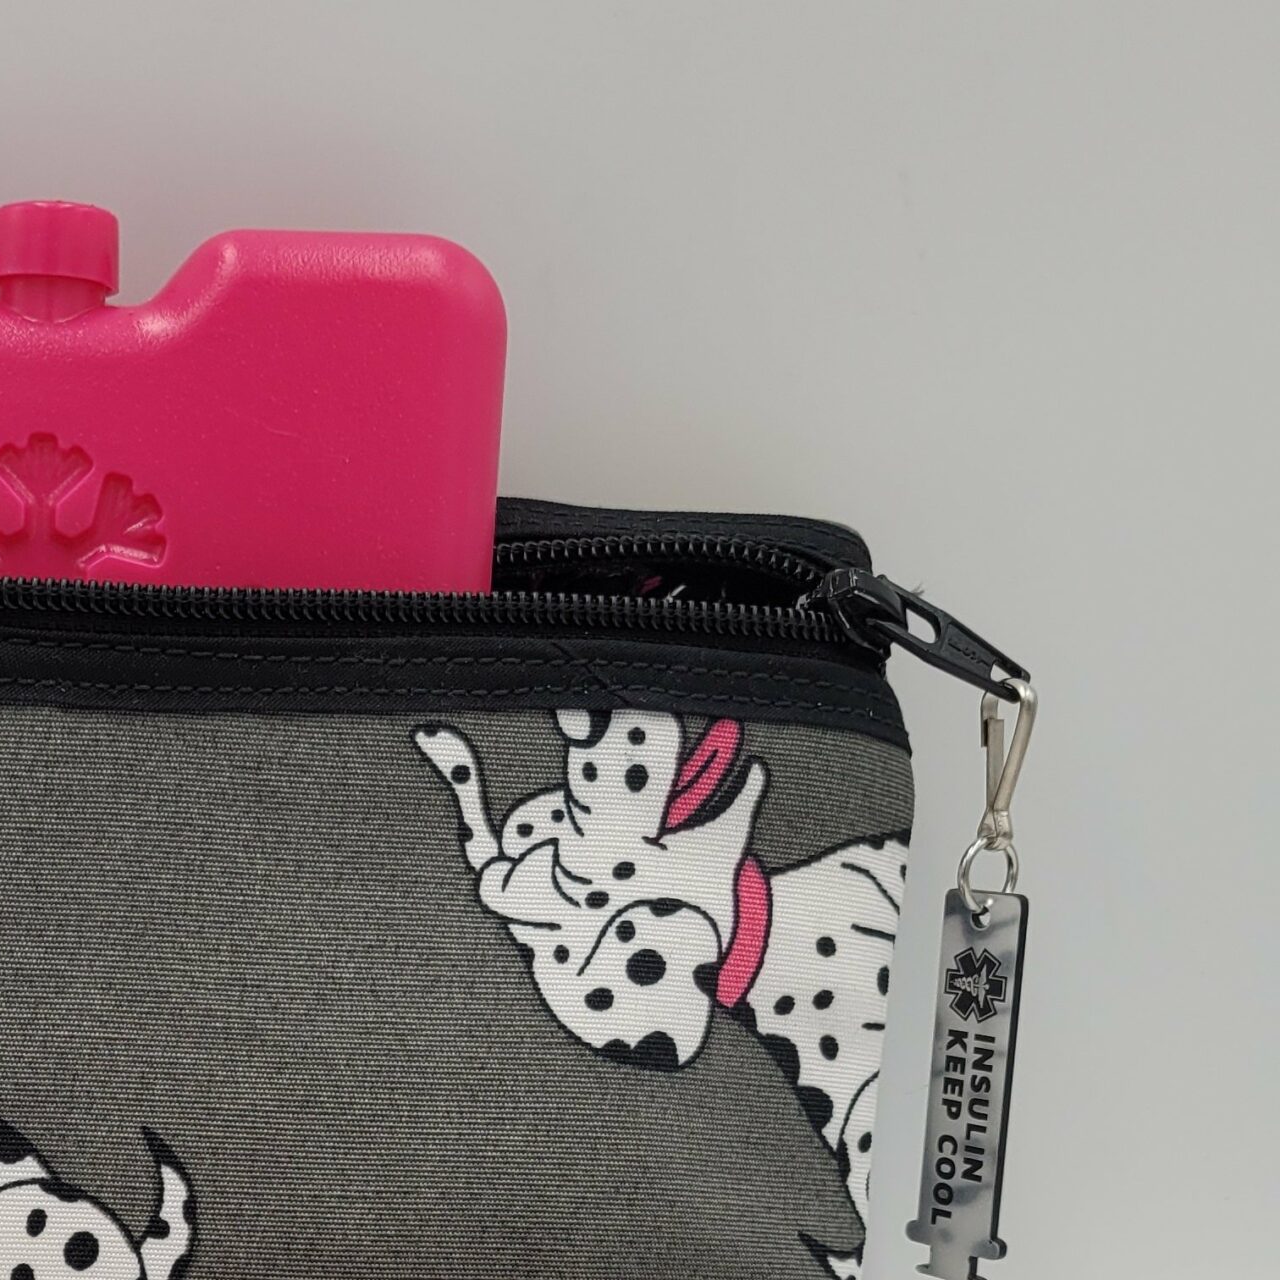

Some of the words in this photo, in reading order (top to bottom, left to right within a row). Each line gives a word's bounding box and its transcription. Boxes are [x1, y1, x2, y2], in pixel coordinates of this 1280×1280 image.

[941, 1028, 969, 1120] KEEP
[961, 1033, 995, 1183] INSULIN
[930, 1134, 958, 1226] COOL
